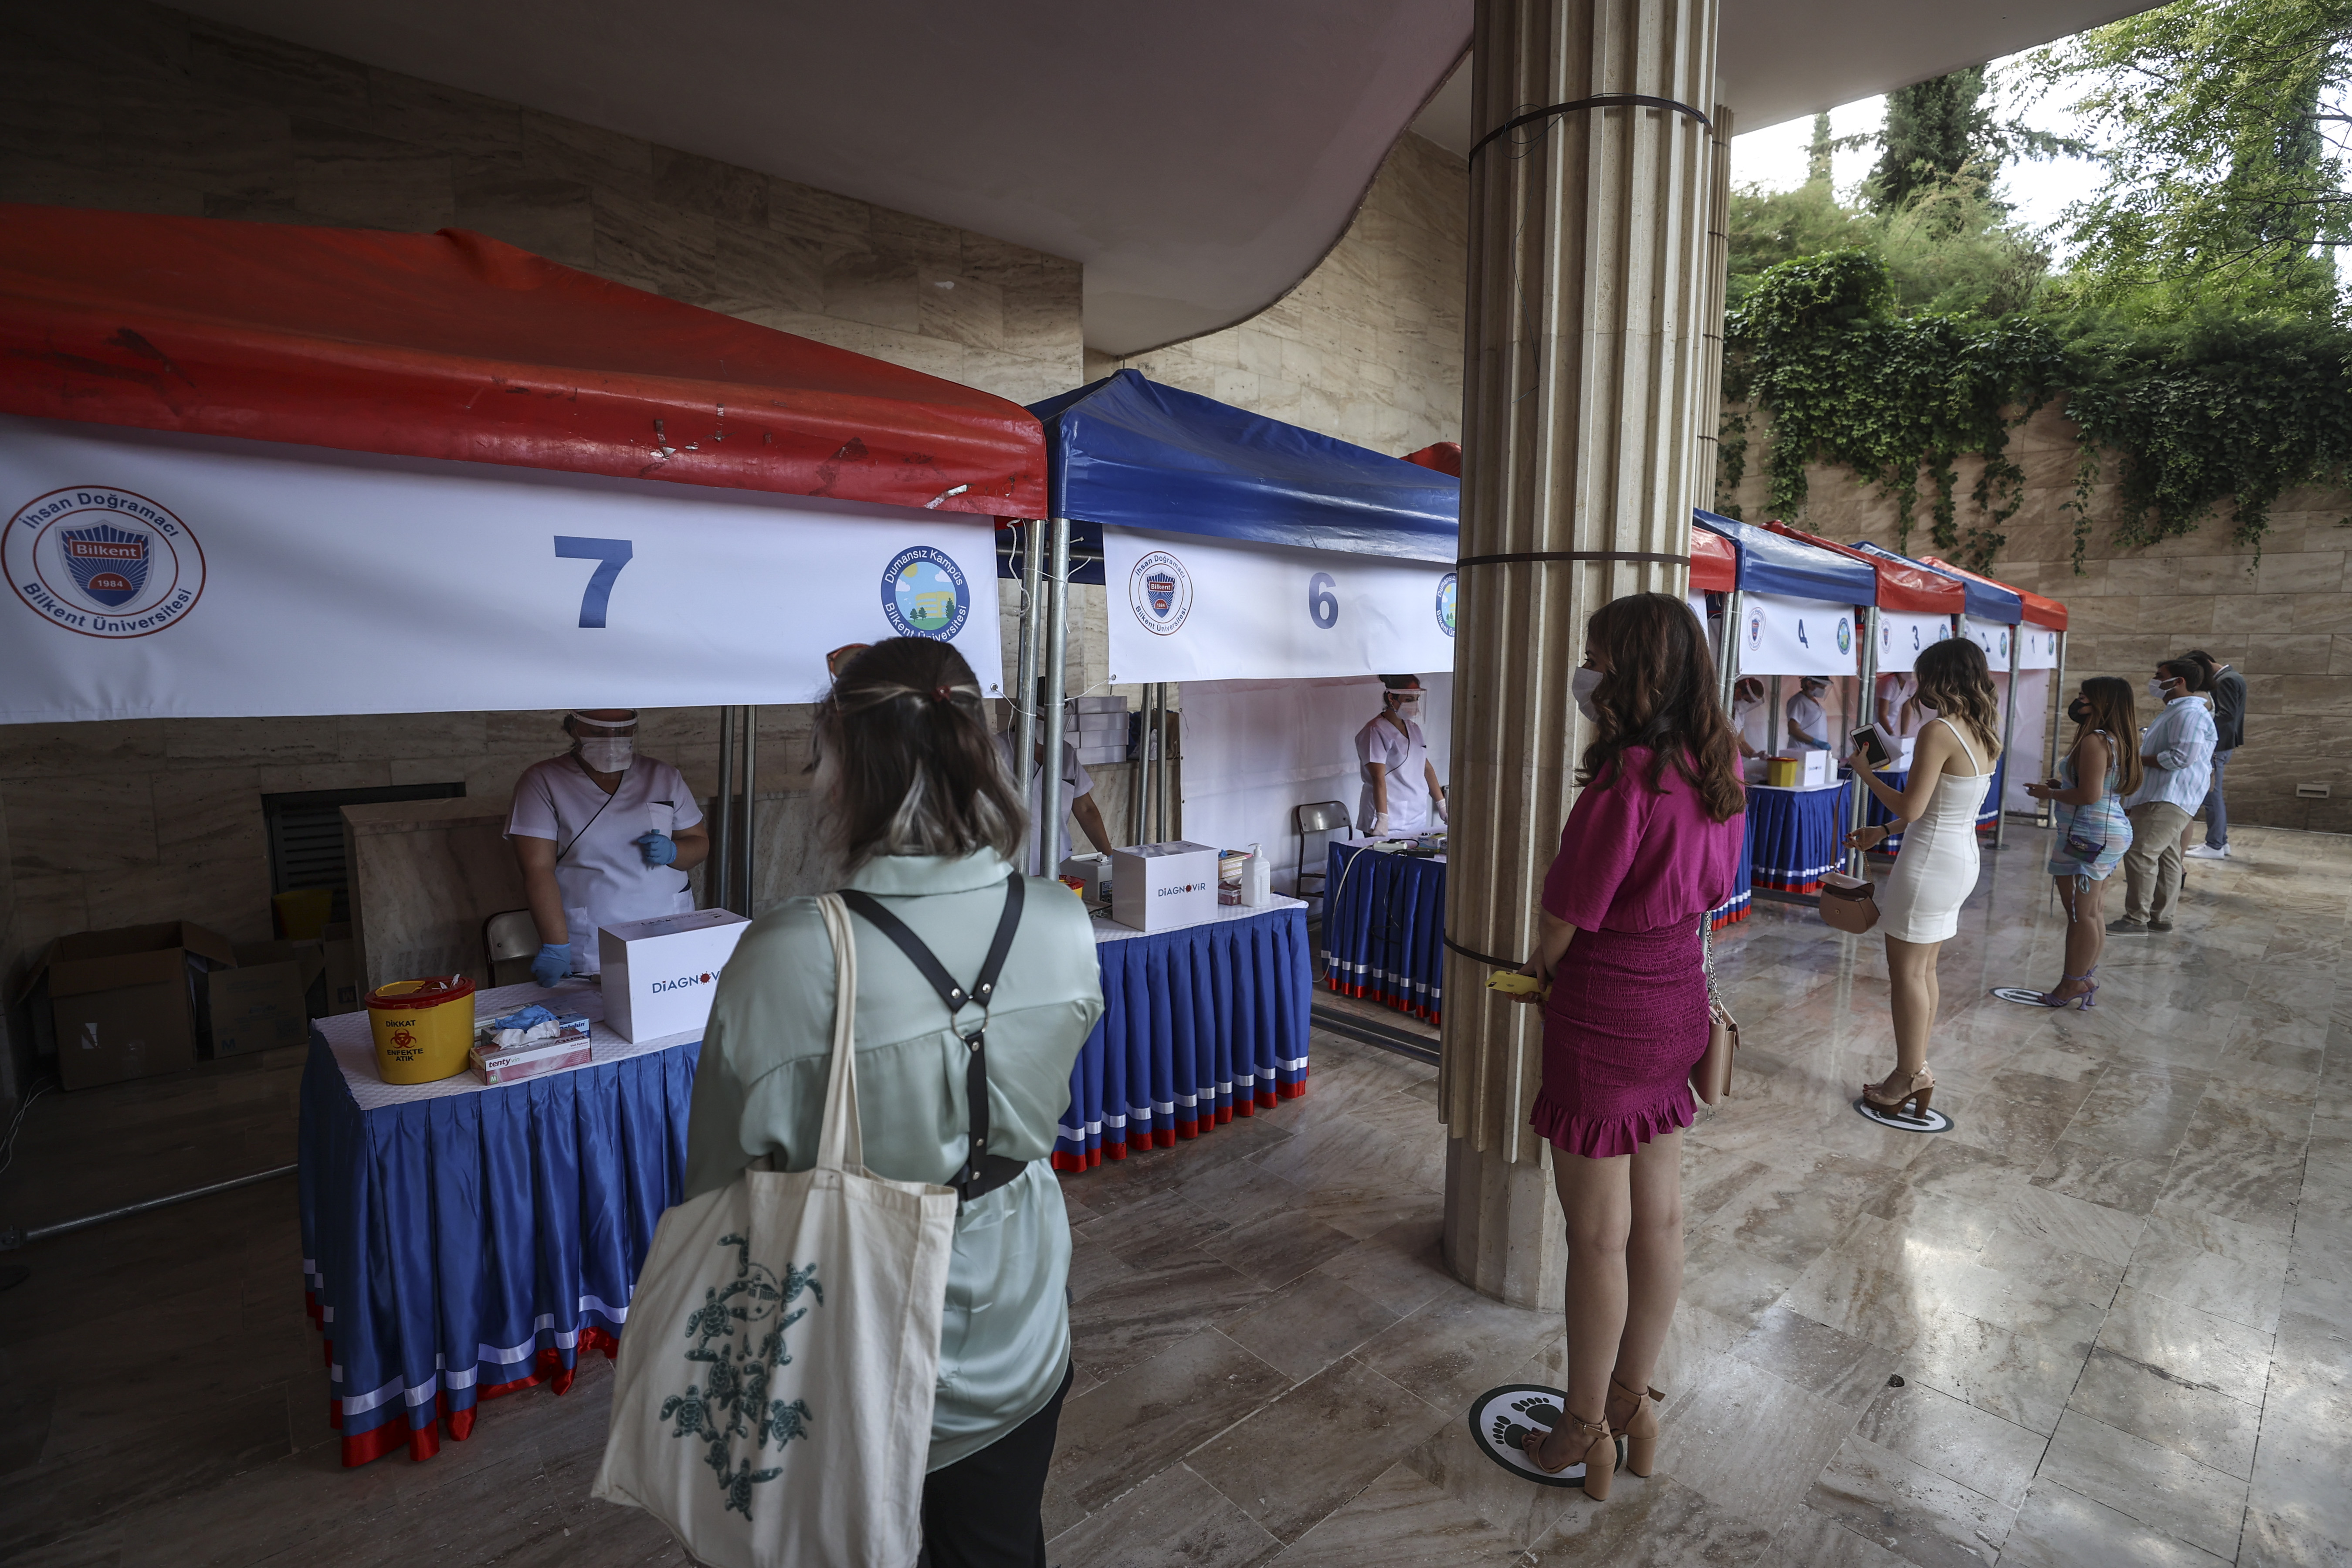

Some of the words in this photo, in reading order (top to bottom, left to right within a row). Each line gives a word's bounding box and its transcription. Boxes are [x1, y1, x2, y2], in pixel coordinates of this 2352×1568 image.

[19, 498, 72, 529] İhsan
[77, 492, 179, 537] Doğramacı
[77, 544, 137, 557] Bilkent
[885, 550, 927, 583] Dumansız
[930, 549, 963, 586] Kampüs
[1135, 558, 1152, 576] İhsan
[1154, 555, 1186, 578] Doğramacı
[554, 535, 633, 628] 7
[1437, 575, 1456, 598] Dumansız
[23, 582, 86, 627] Bilkent
[93, 588, 192, 632] Üniversitesi
[1308, 572, 1339, 629] 6
[1135, 606, 1155, 629] Bilkent
[1157, 607, 1186, 632] Üniversitesi
[1437, 610, 1448, 633] Bilkent
[1799, 619, 1809, 648] 4
[1912, 625, 1920, 651] 3
[1982, 632, 1991, 652] 2
[2032, 635, 2036, 654] 1
[489, 1058, 511, 1068] tenty
